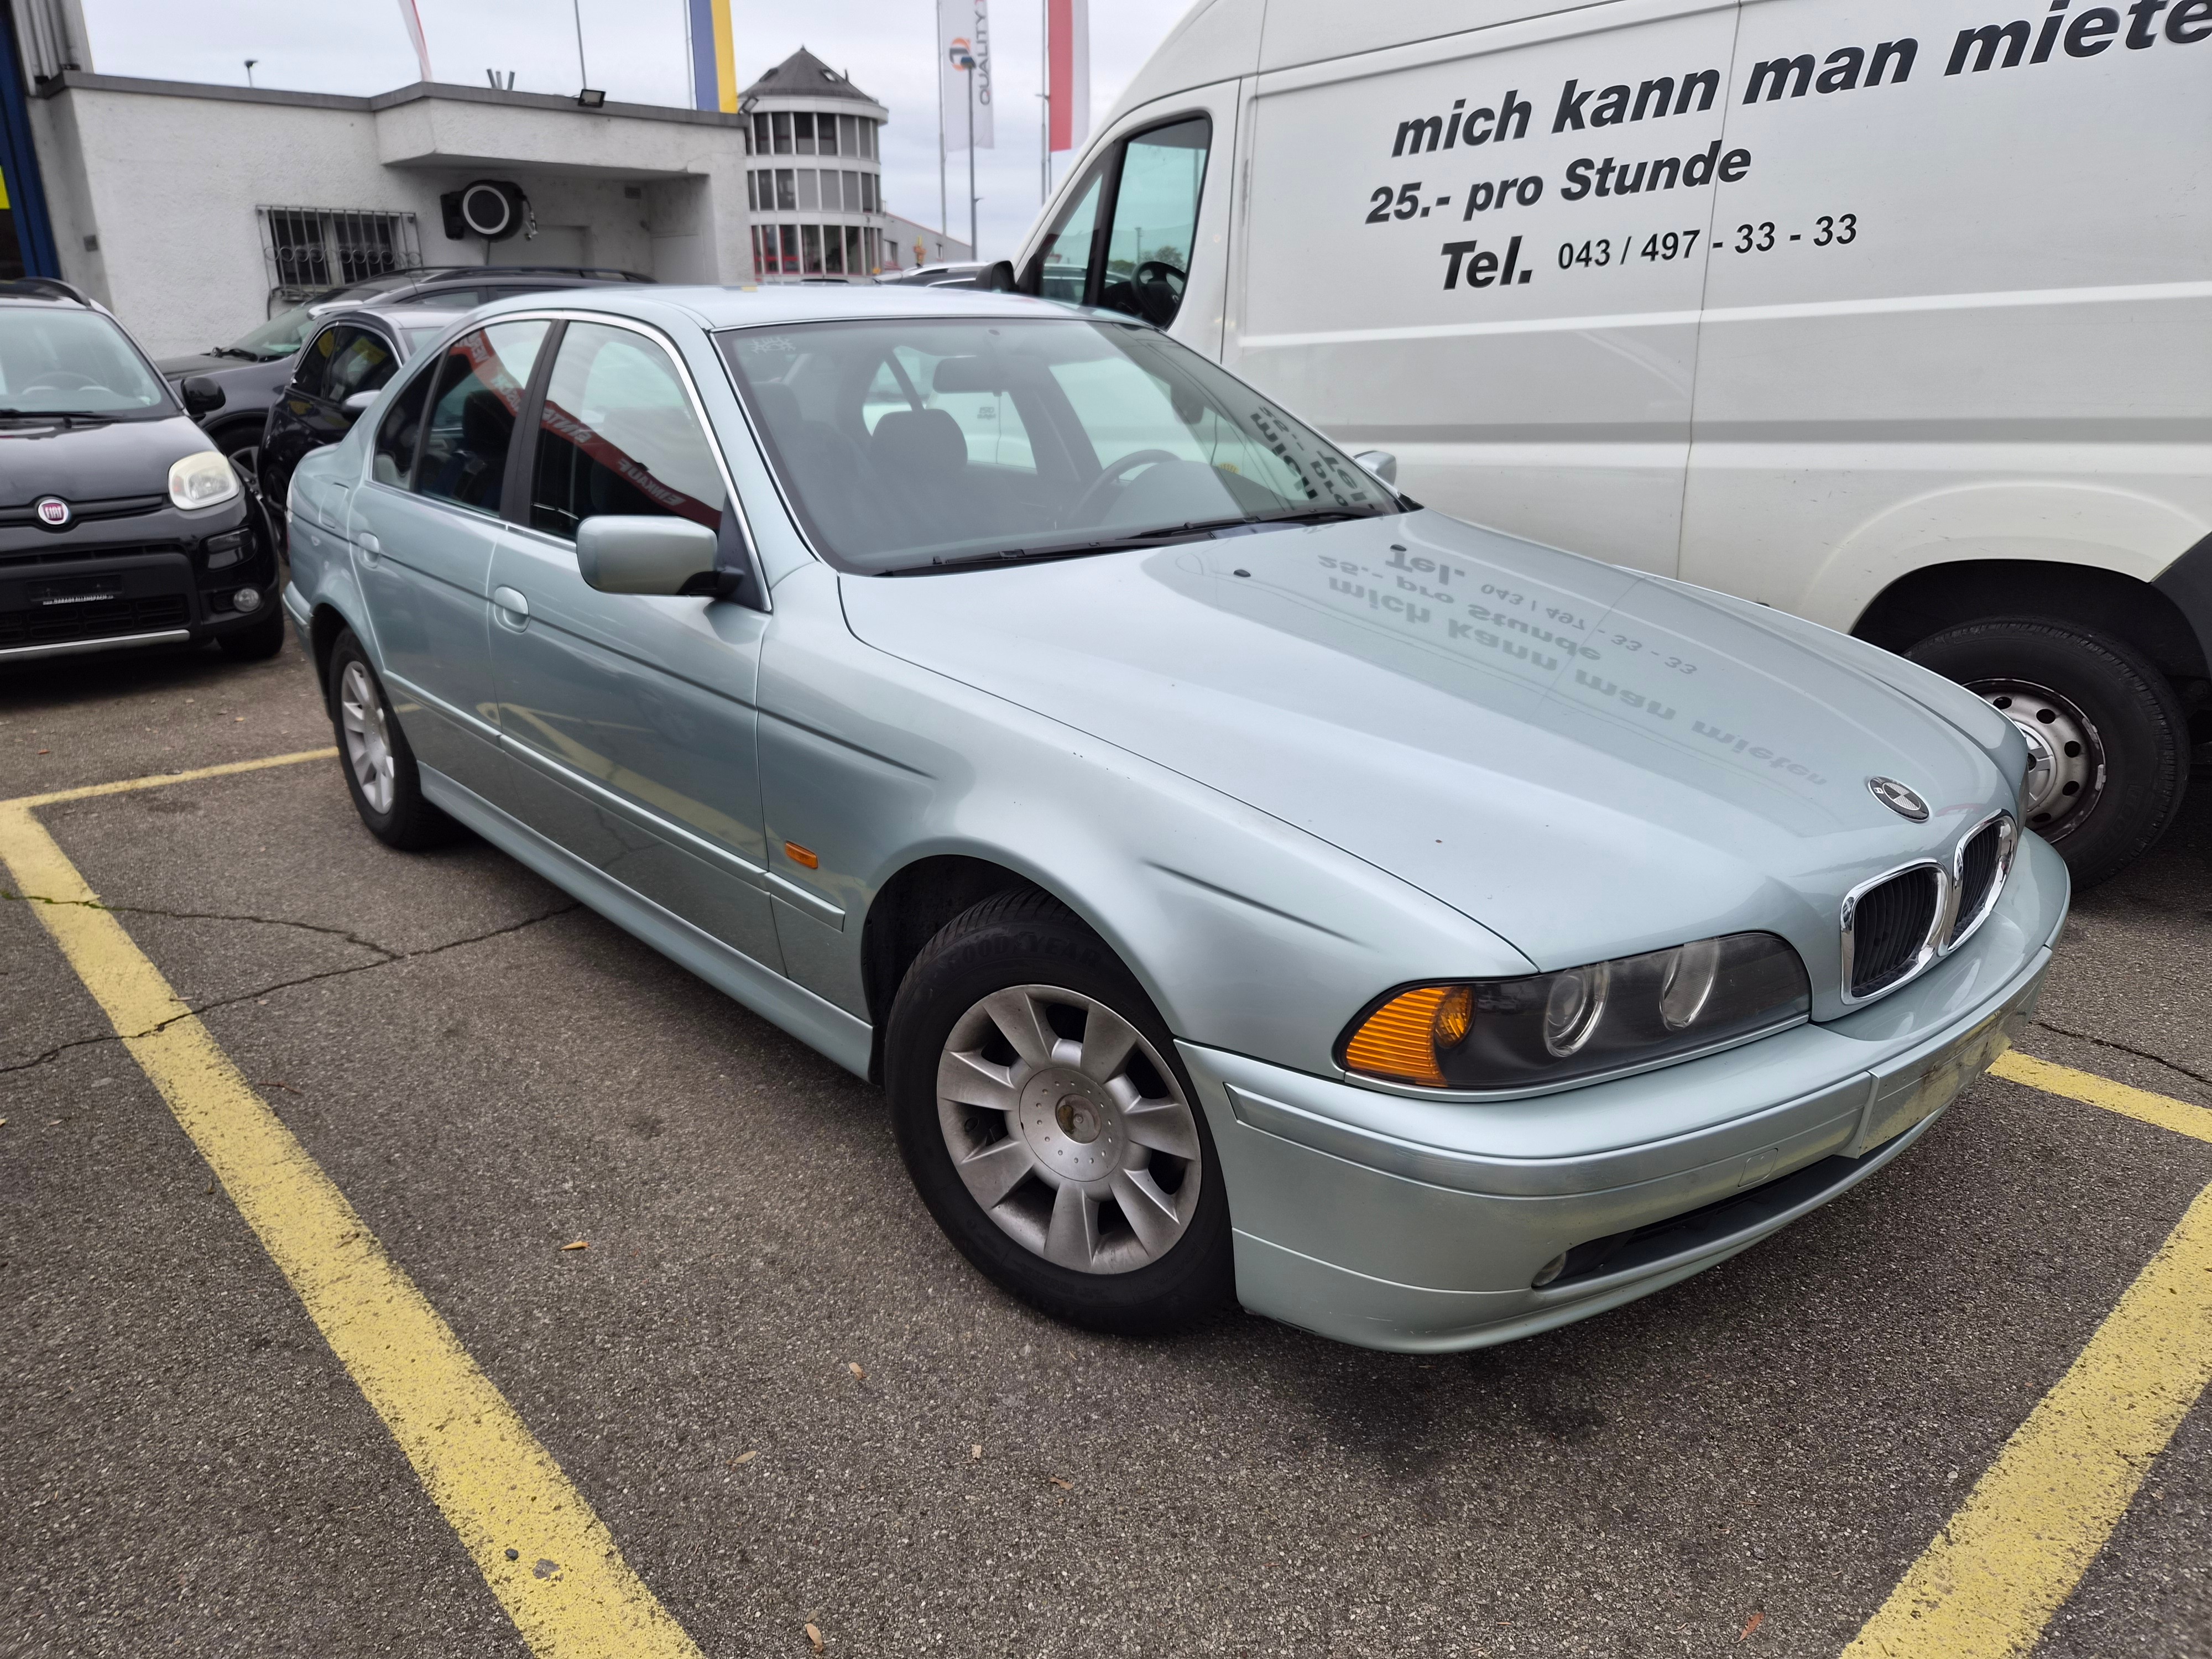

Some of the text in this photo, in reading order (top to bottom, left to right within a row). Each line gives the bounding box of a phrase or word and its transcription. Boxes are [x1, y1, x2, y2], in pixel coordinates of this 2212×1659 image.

[974, 10, 991, 106] QUALITY
[1391, 89, 1532, 158] mich
[1551, 69, 1720, 134] kann
[1741, 37, 1919, 106] man
[1365, 138, 1752, 225] 25.- pro Stunde
[1440, 234, 1533, 291] Tel.
[1557, 238, 1611, 270] 043
[1640, 229, 1701, 262] 497
[1734, 221, 1776, 254] 33
[1813, 213, 1858, 247] 33
[45, 505, 62, 519] FIAT
